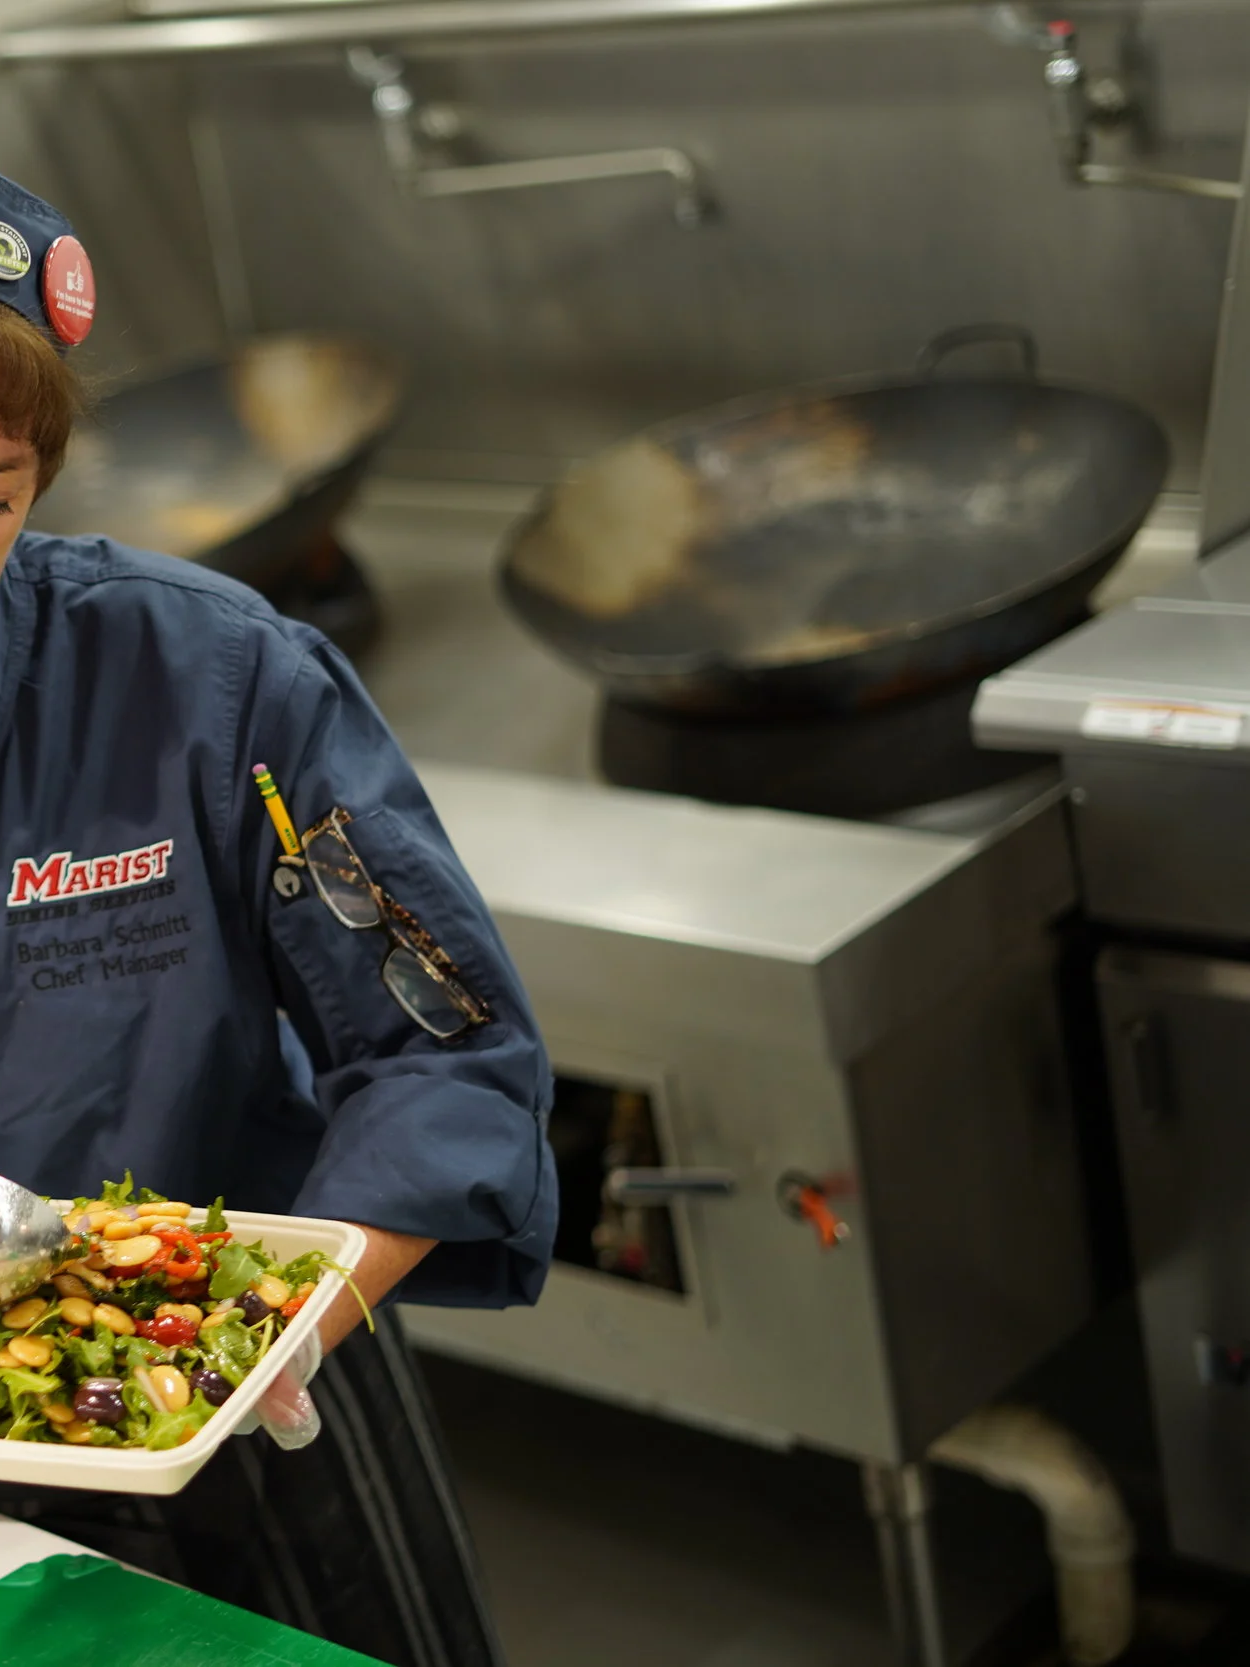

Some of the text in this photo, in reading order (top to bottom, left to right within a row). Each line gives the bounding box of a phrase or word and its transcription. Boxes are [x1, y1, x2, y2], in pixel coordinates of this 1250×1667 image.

[7, 839, 174, 907] MARIST
[89, 880, 177, 912] SERVICES
[17, 914, 191, 965] Barbara Schmitt
[31, 946, 188, 991] Chef Manager
